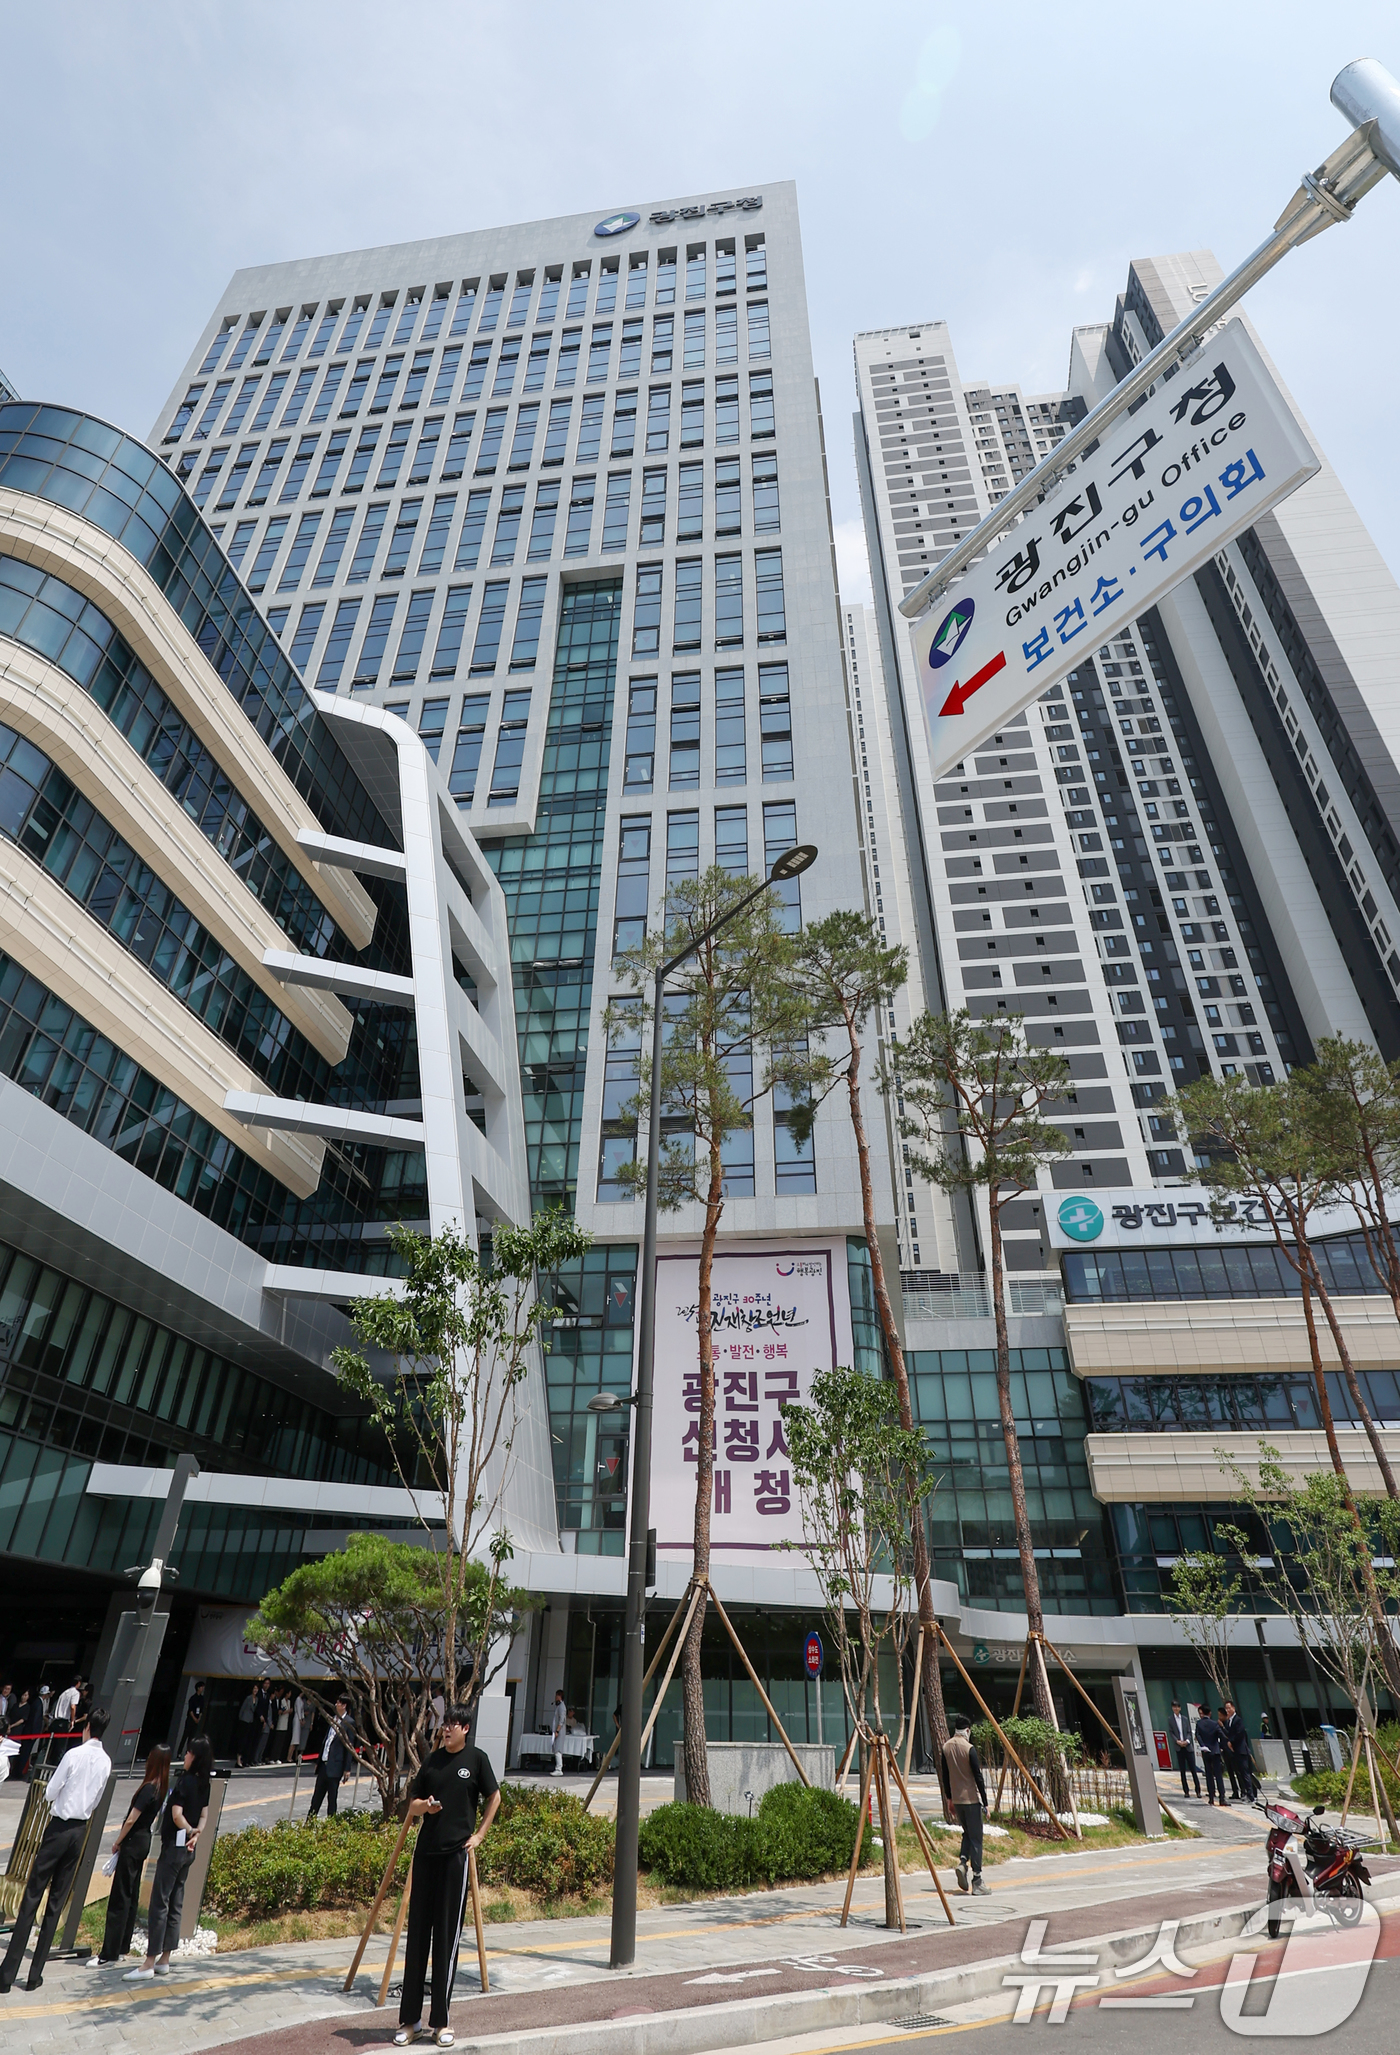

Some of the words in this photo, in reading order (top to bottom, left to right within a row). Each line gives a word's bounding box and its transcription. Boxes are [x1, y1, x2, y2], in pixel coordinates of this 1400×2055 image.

[649, 195, 763, 223] 광진구청
[994, 362, 1236, 594] 광진구청
[1005, 489, 1155, 627] Gwangjin-gu
[1161, 411, 1247, 487] Office
[713, 1293, 740, 1307] 광진구
[743, 1293, 772, 1306] 30주년
[682, 1370, 800, 1412] 광진구
